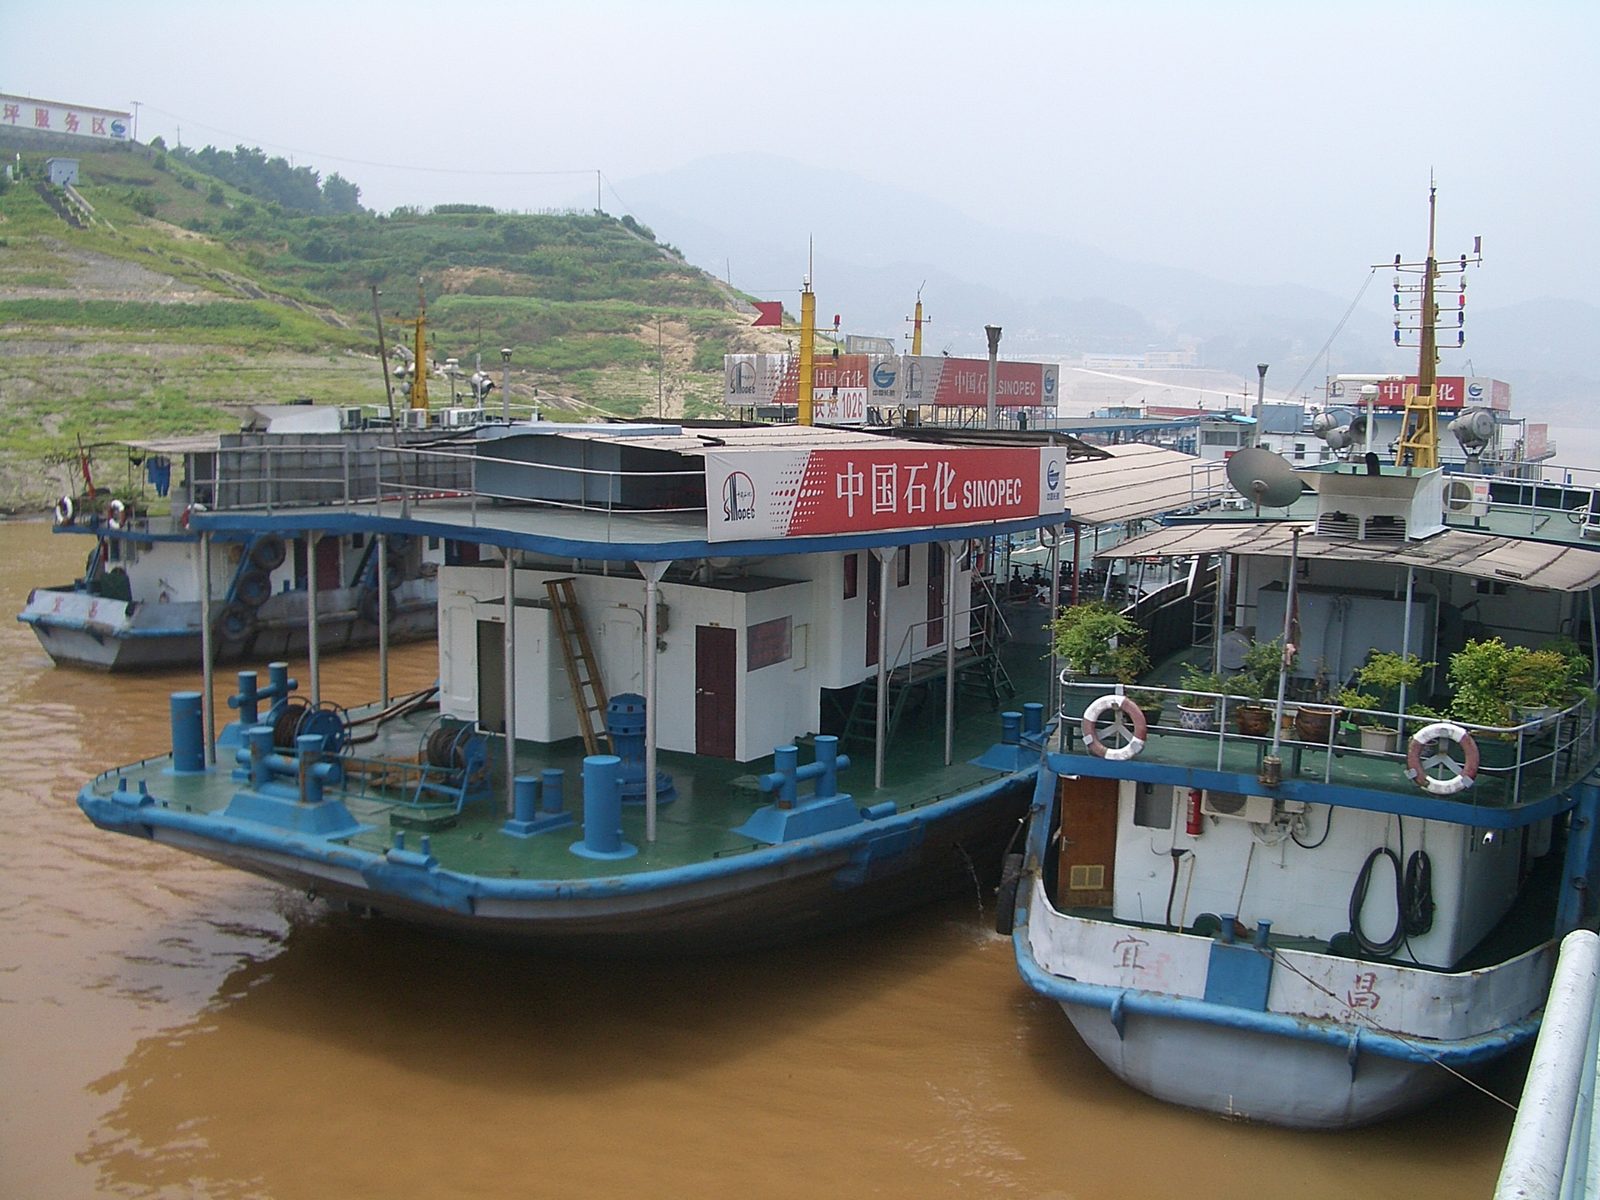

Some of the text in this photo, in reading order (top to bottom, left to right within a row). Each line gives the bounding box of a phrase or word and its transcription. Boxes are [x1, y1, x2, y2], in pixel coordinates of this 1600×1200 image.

[999, 380, 1036, 396] SINOPEC
[836, 461, 1022, 518] 中国石化 SINOPEC
[1347, 972, 1381, 1010] 昌
